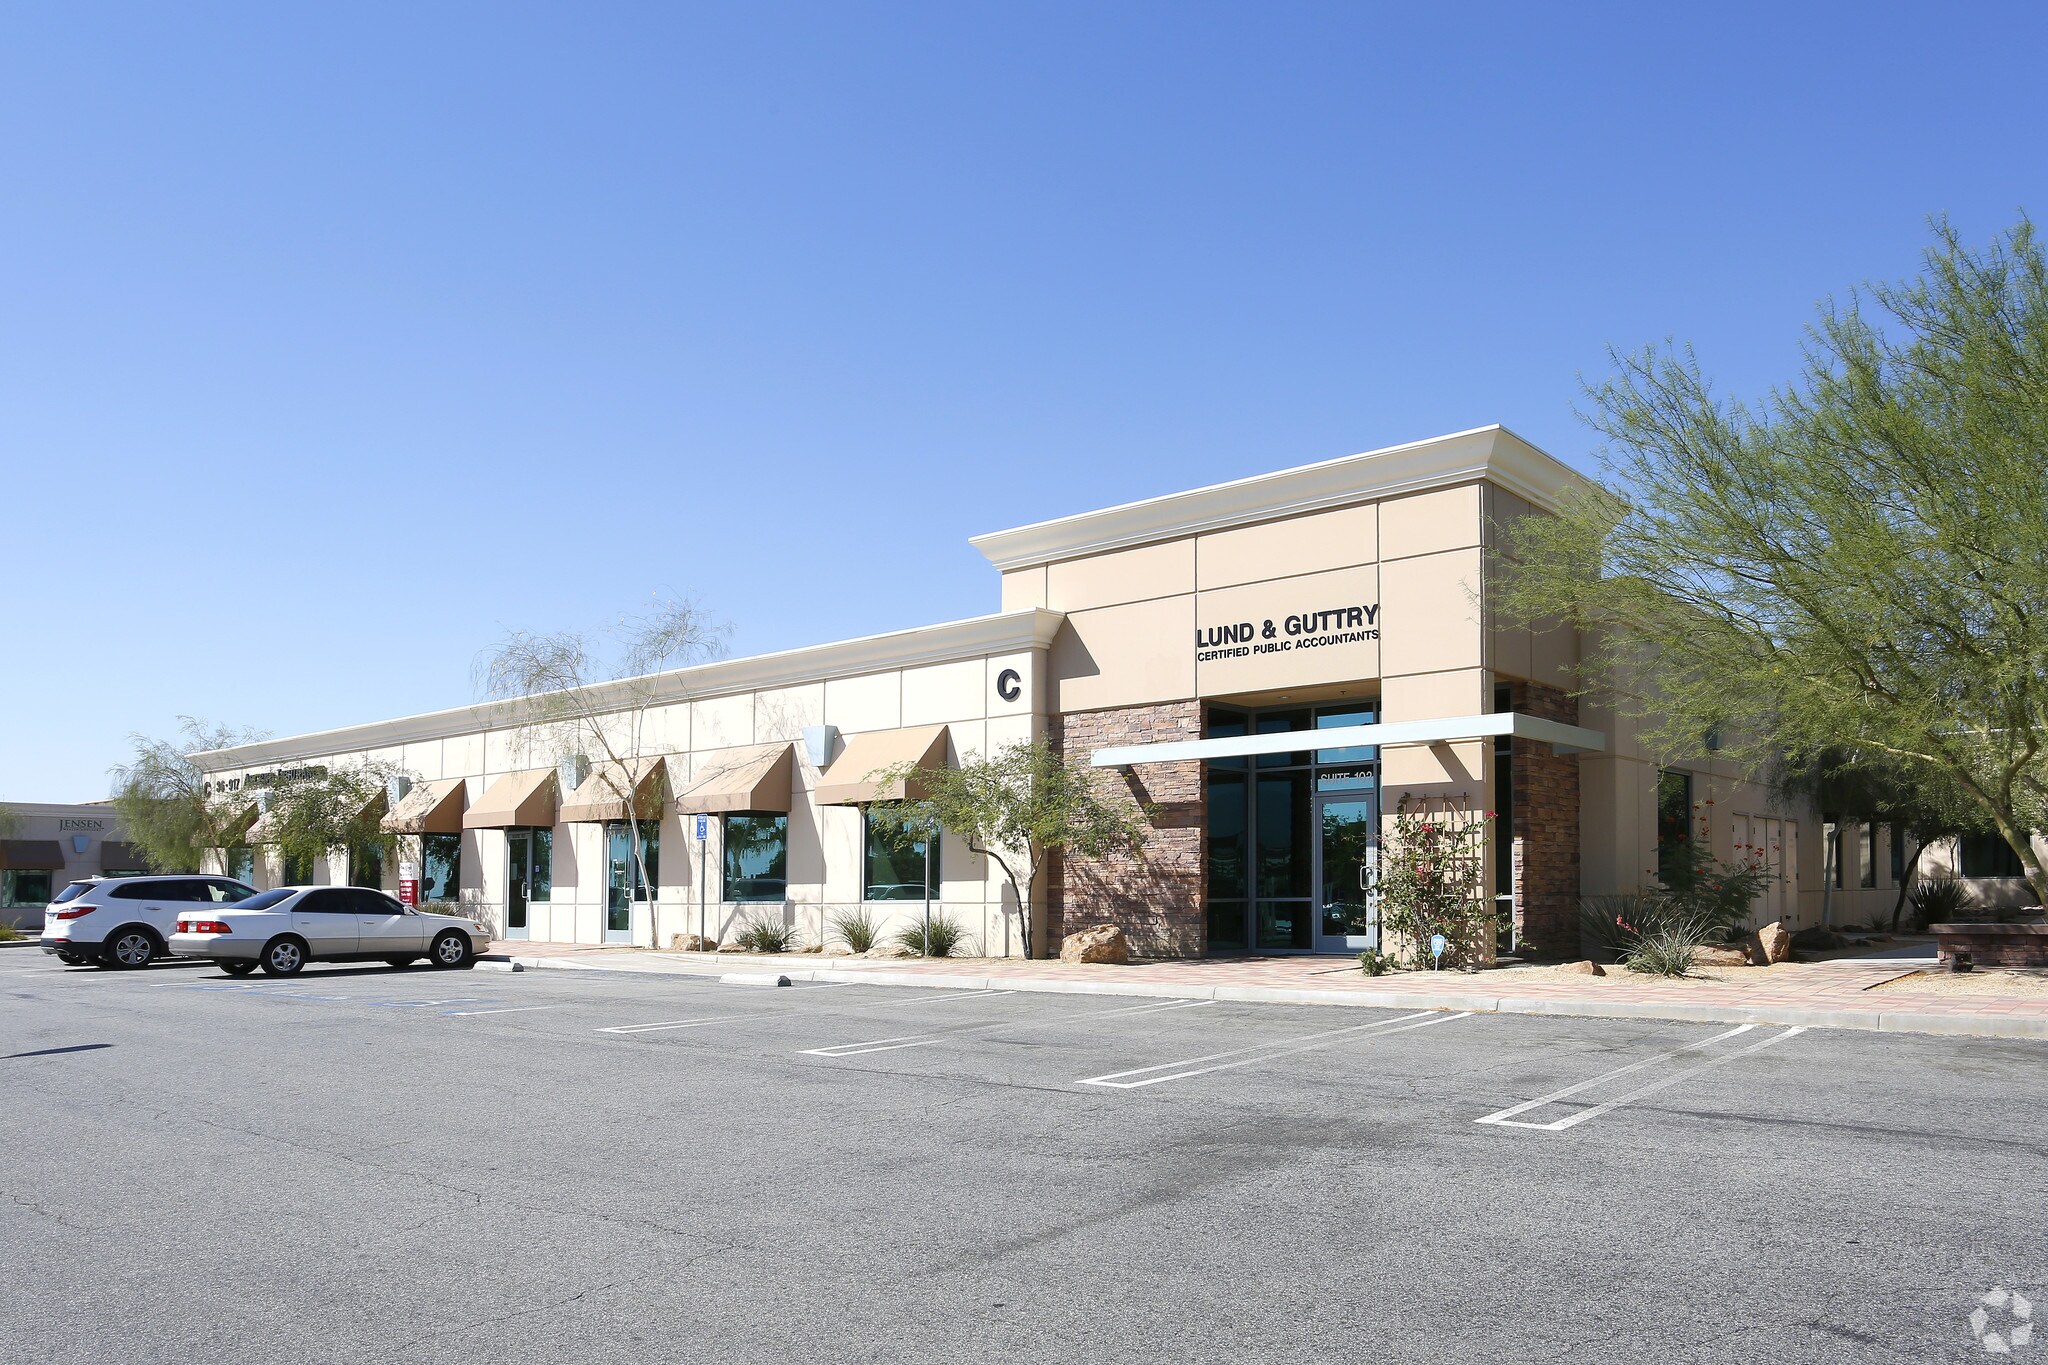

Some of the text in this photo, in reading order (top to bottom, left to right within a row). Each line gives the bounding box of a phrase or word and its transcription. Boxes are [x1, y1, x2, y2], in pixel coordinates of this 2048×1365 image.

[1196, 603, 1380, 648] LUND & GUTTRY
[1197, 629, 1380, 662] CERTIFIED PUBLIC ACCOUNTANTS
[997, 668, 1021, 701] C
[1320, 772, 1350, 786] SUITE
[59, 819, 102, 832] JENSEN
